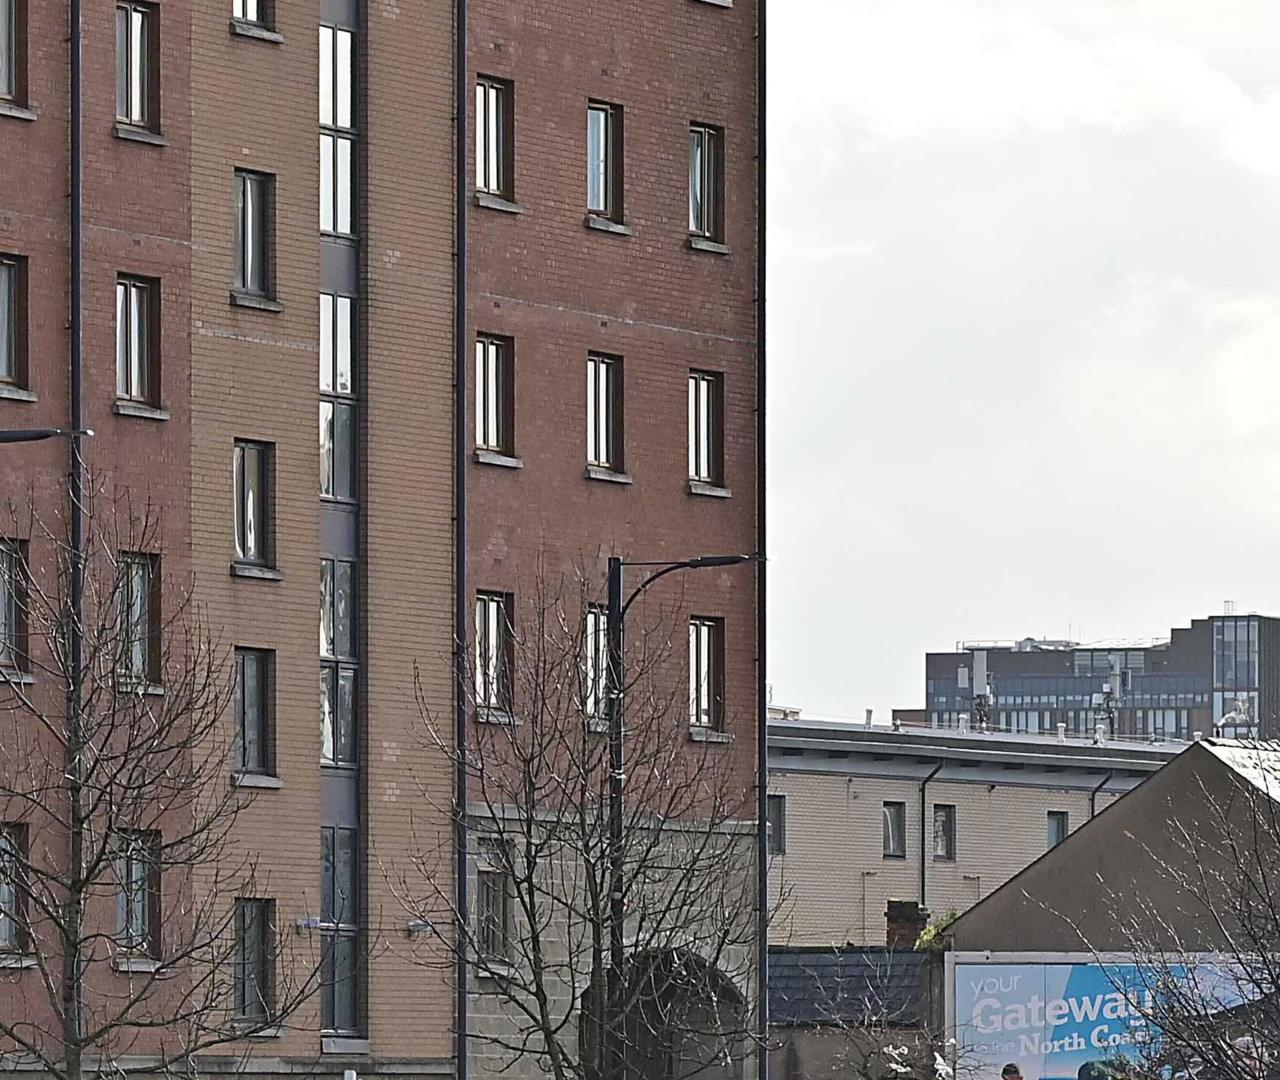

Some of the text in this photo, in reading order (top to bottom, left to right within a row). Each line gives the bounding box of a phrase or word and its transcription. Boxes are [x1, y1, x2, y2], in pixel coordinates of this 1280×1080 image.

[969, 974, 1023, 999] your
[972, 989, 1153, 1034] Gateway
[1018, 1031, 1086, 1057] North
